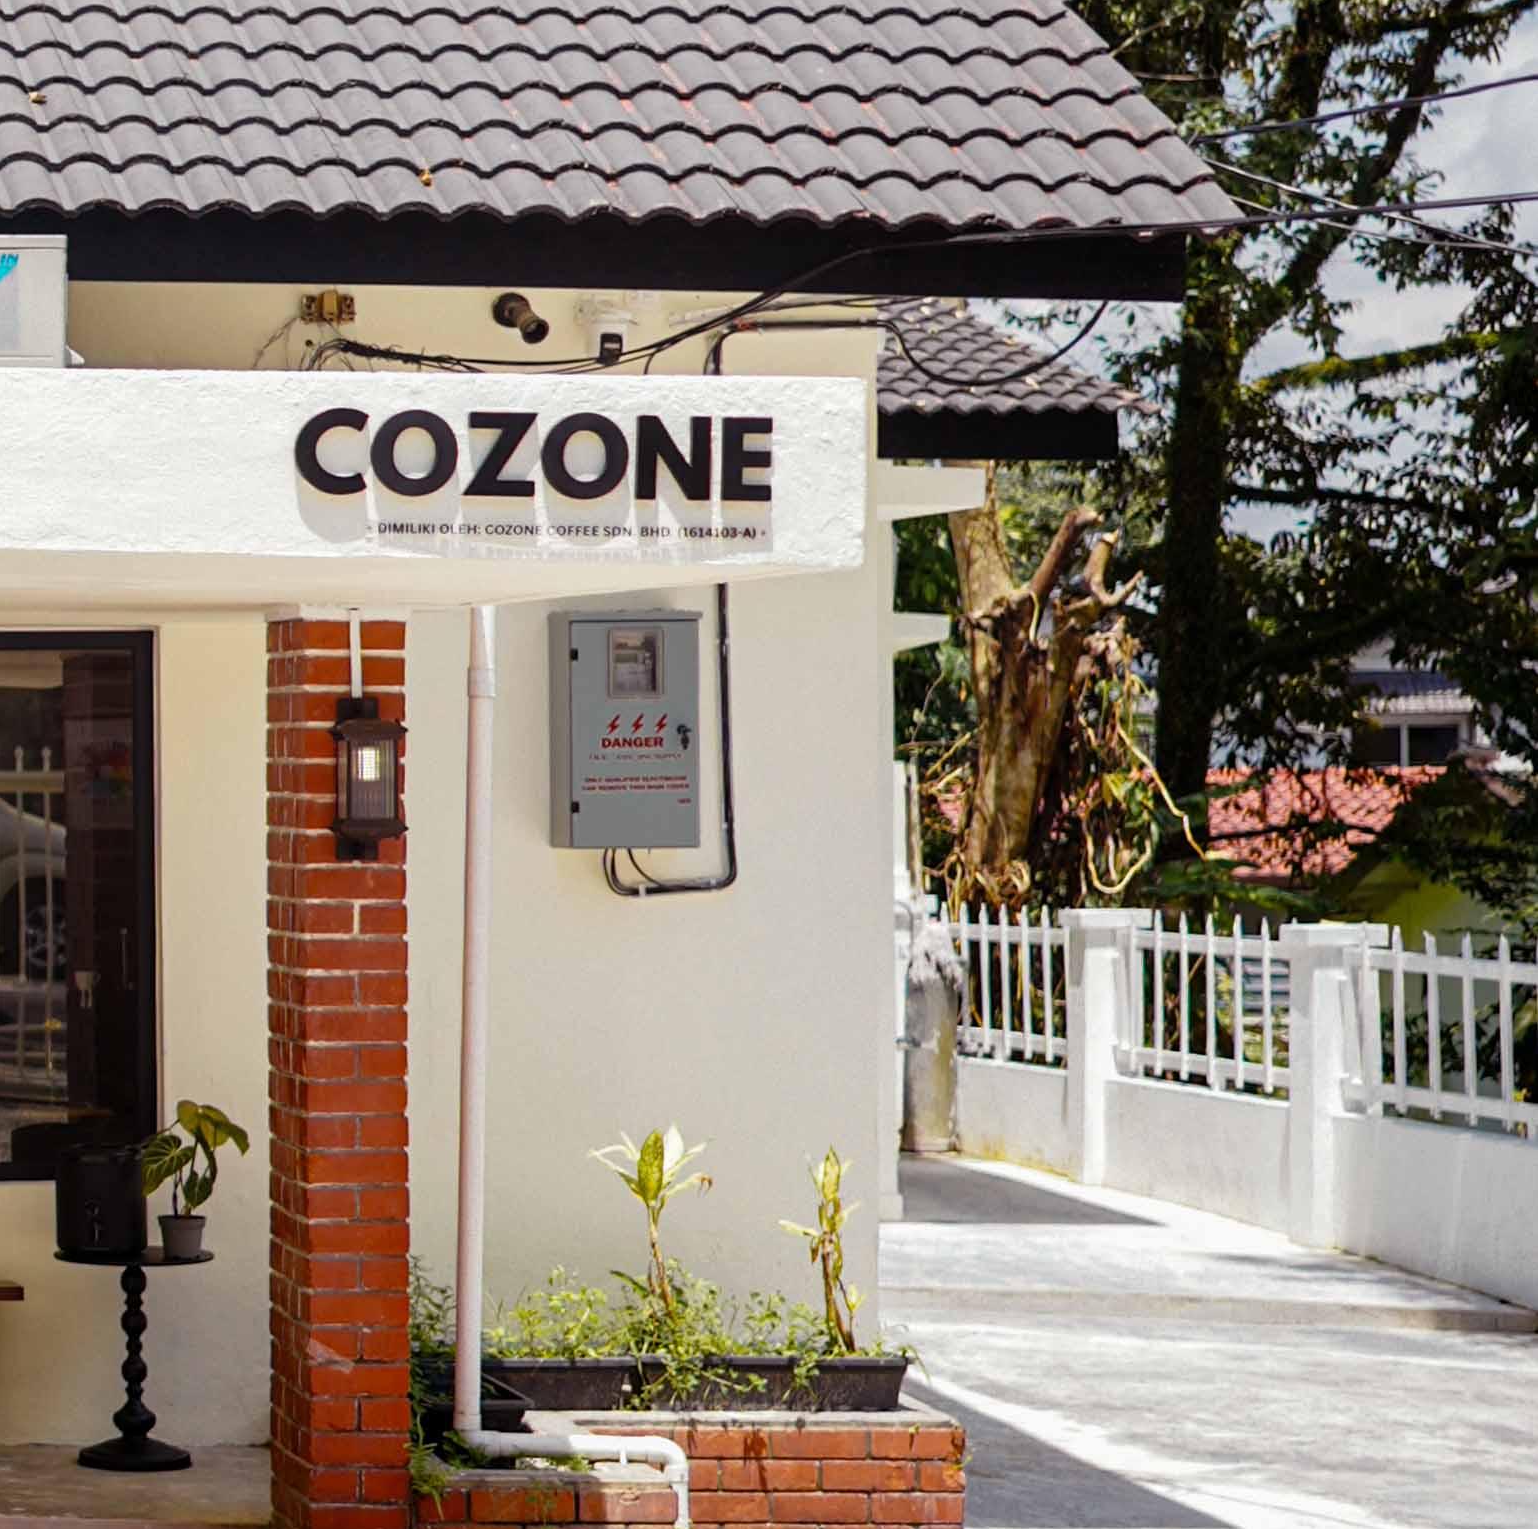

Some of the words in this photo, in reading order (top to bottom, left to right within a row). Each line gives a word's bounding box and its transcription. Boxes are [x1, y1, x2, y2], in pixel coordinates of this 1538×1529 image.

[294, 408, 773, 500] COZONE
[377, 522, 435, 534] DIMILIKI
[439, 522, 482, 535] OLEH:
[485, 523, 542, 535] COZONE
[547, 524, 599, 537] COFFEE
[601, 737, 664, 748] DANGER
